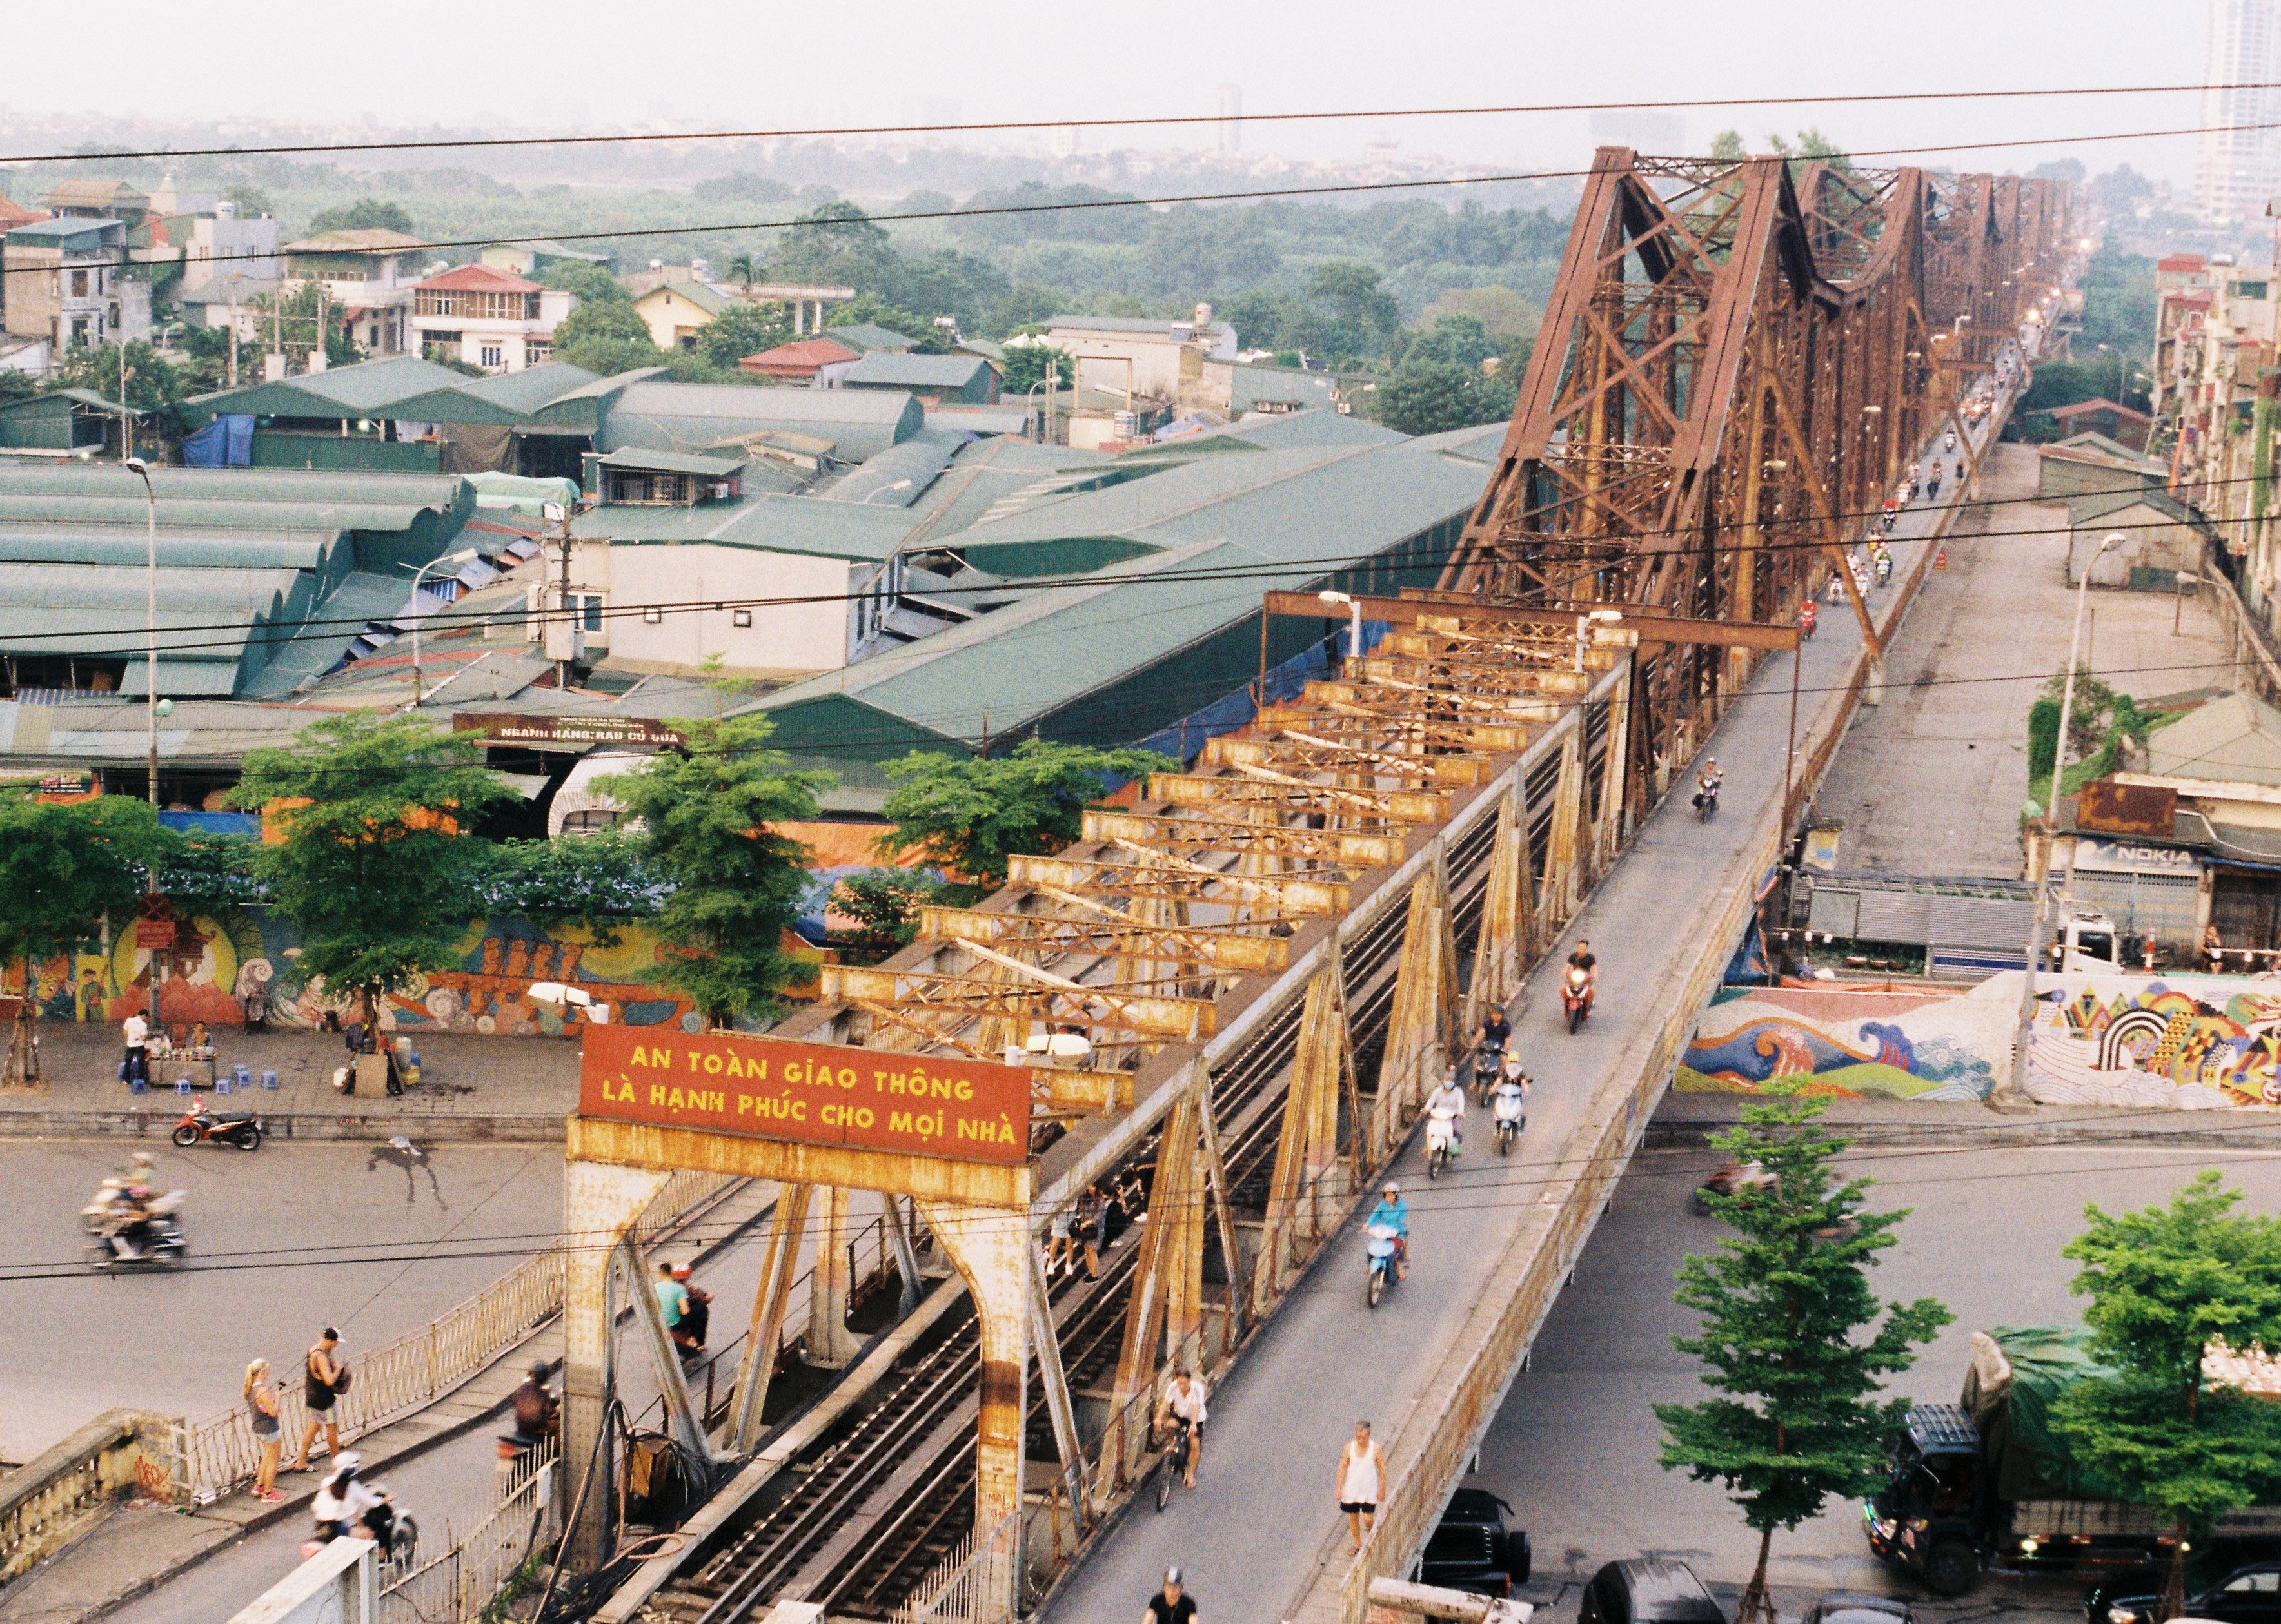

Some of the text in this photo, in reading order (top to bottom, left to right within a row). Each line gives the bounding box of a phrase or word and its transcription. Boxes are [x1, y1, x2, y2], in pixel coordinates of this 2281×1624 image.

[595, 731, 624, 740] RAU
[2117, 846, 2193, 863] NOKIA
[630, 1046, 672, 1069] AN
[687, 1048, 767, 1080] TOÀN
[873, 1067, 974, 1101] THÔNG
[602, 1073, 636, 1103] LÀ
[649, 1084, 725, 1113] HẠNH
[738, 1089, 807, 1121] PHÚC
[820, 1104, 874, 1128] CHO
[957, 1111, 1016, 1145] NHÀ
